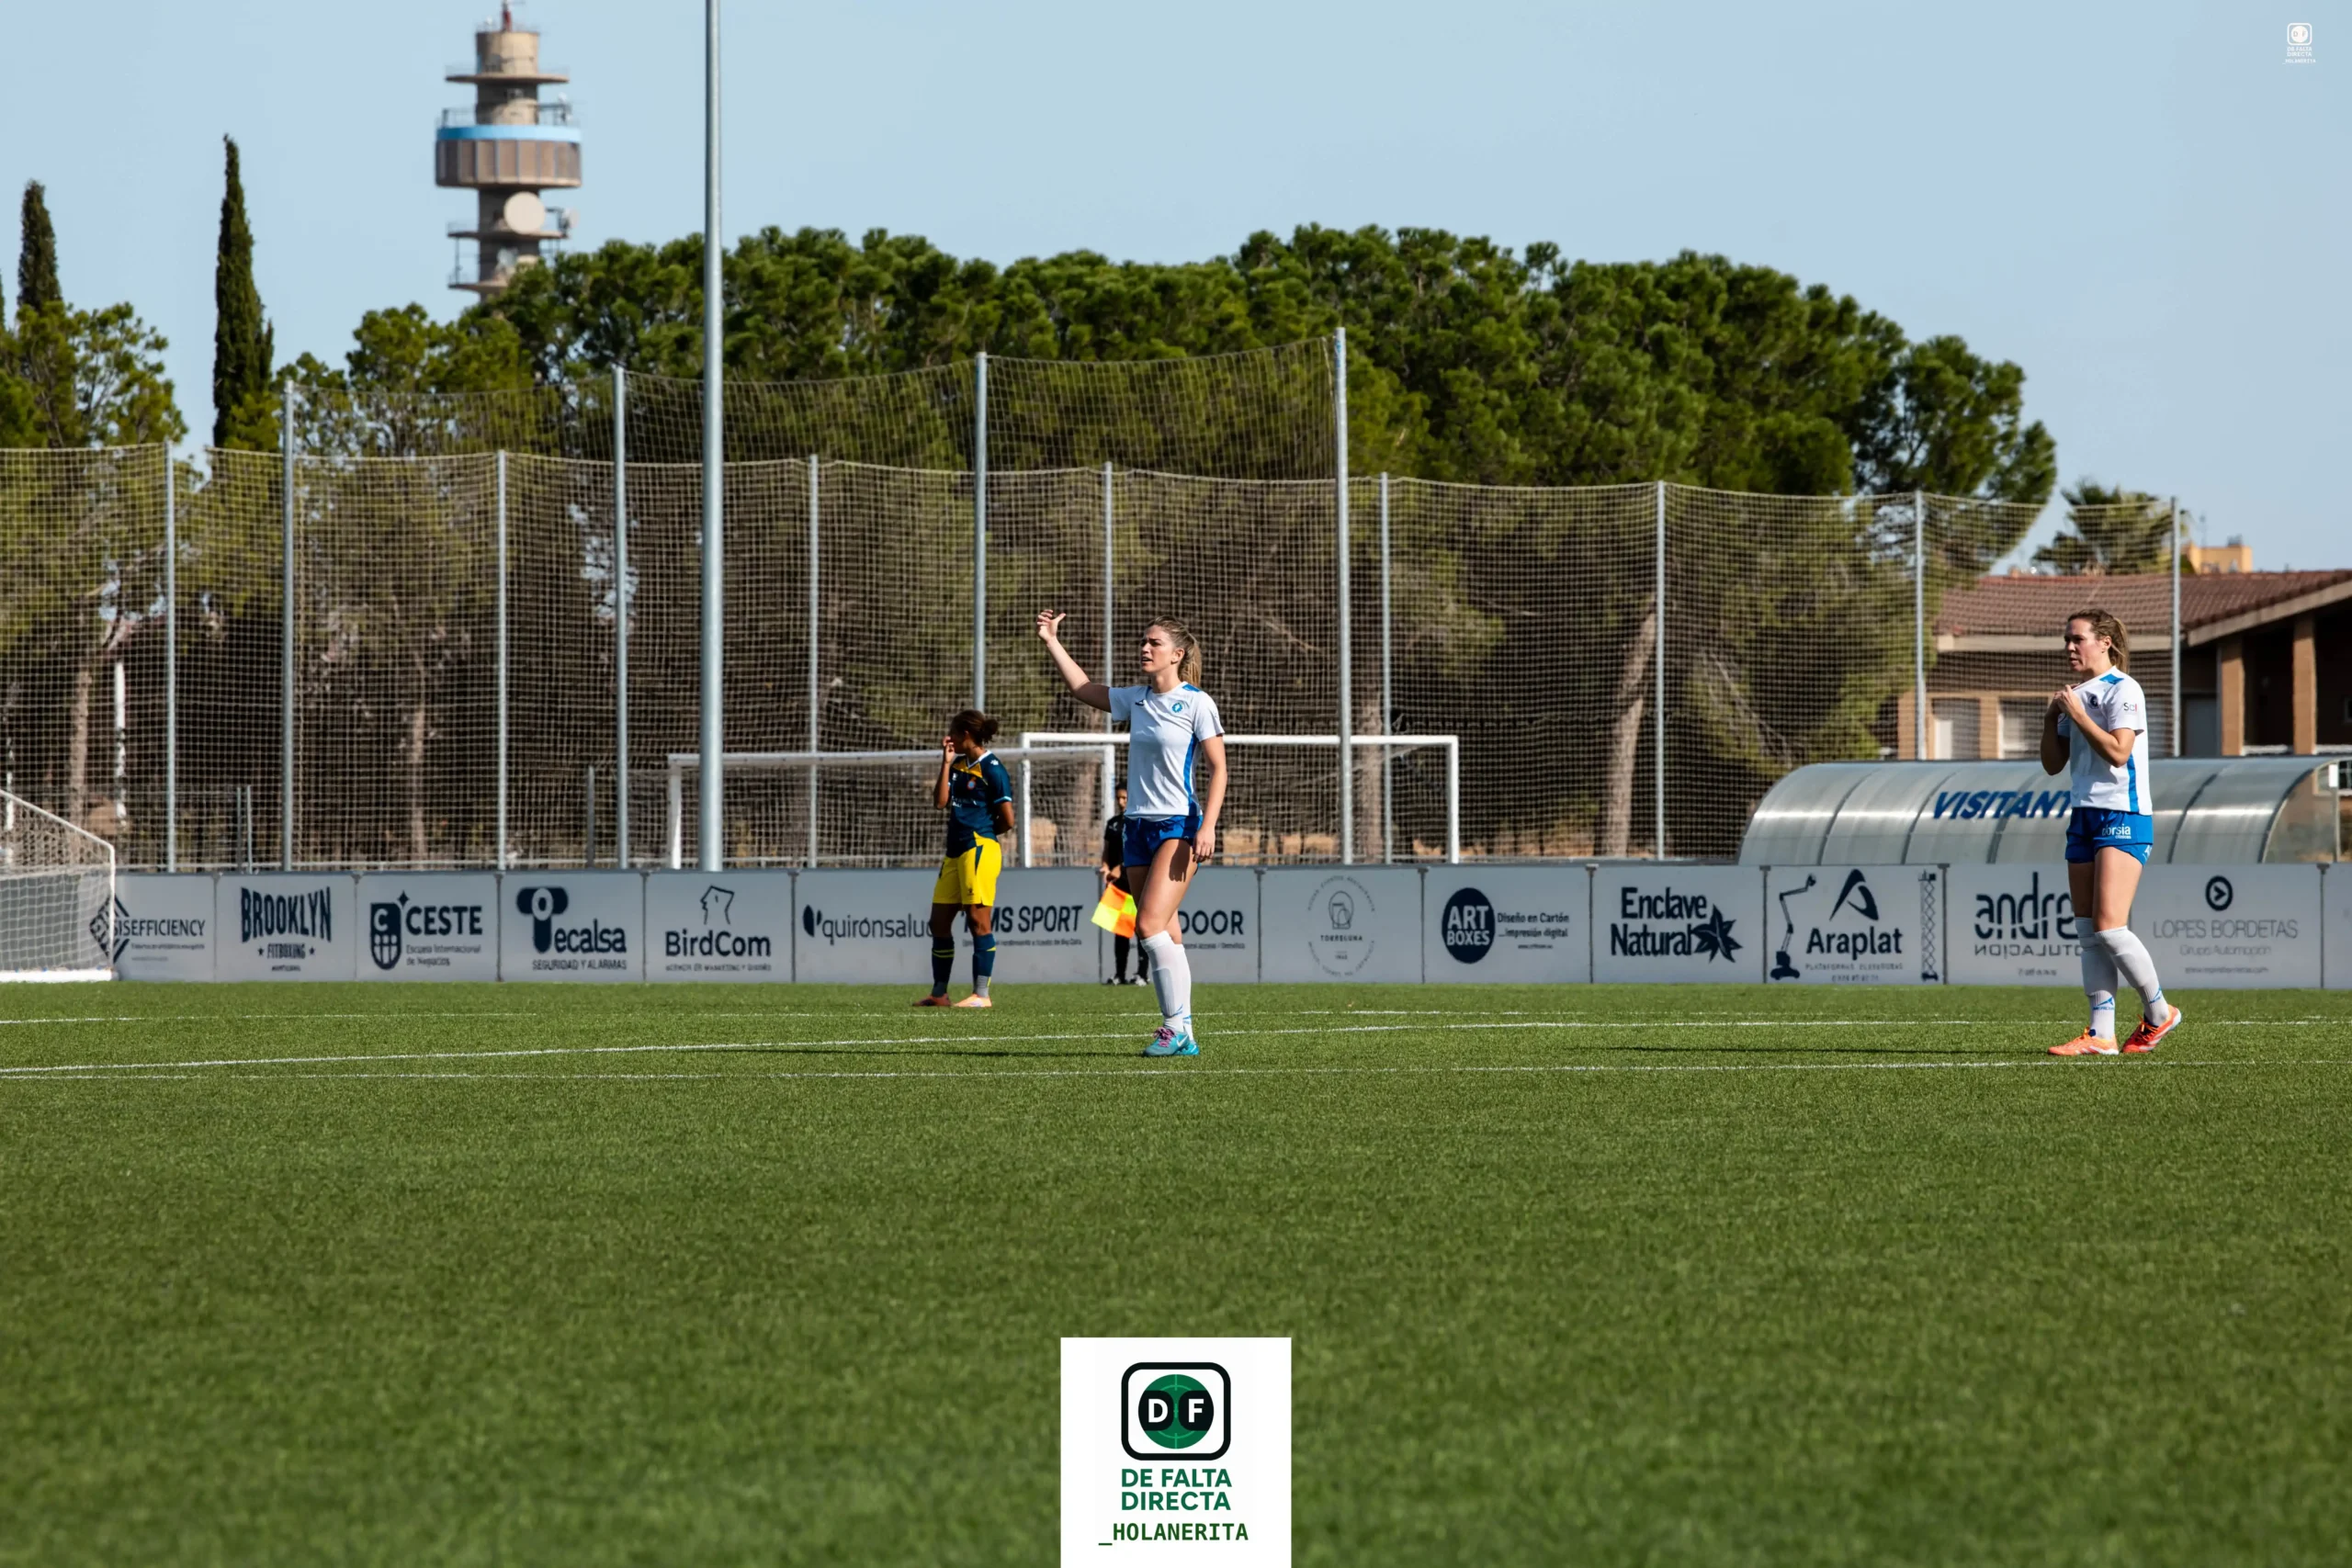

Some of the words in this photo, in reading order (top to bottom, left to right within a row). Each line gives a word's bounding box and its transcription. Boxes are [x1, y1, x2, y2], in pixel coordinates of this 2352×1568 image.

[1934, 790, 2071, 819] VISITANT
[241, 886, 333, 943] BROOKLYN
[1498, 910, 1526, 923] Diseño
[1527, 914, 1538, 923] en
[1540, 910, 1570, 923] Cartón
[1621, 886, 1707, 919] Enclave
[1974, 871, 2079, 940] andre
[405, 905, 483, 936] CESTE
[1018, 905, 1083, 933] SPORT
[1177, 909, 1245, 935] DOOR
[1446, 905, 1489, 930] ART
[2153, 919, 2207, 939] LOPES
[2211, 919, 2299, 939] BORDETAS
[665, 929, 771, 957] BirdCom
[1446, 930, 1490, 946] BOXES
[1611, 923, 1693, 956] Natural
[1805, 926, 1903, 961] Araplat
